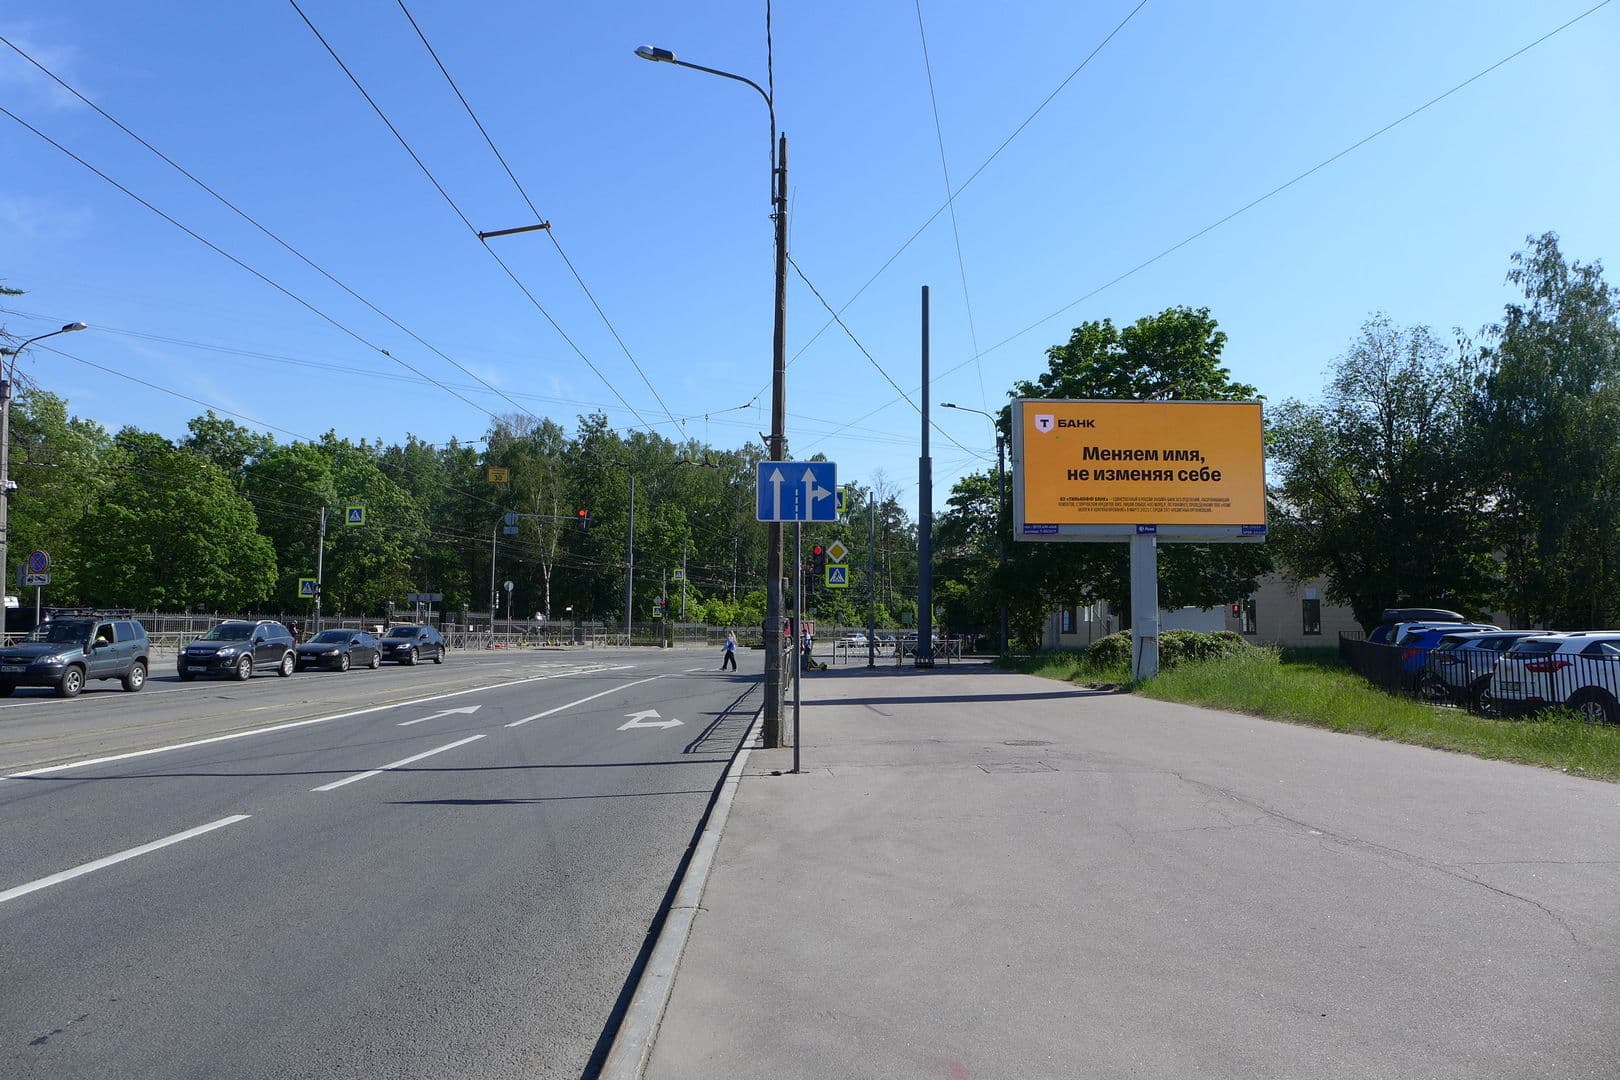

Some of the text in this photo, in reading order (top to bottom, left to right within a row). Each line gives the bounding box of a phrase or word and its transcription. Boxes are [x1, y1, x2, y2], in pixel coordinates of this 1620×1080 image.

[1058, 419, 1096, 428] БАНК
[1082, 446, 1206, 464] Меняем имя,
[1067, 466, 1222, 482] не изменяя себе
